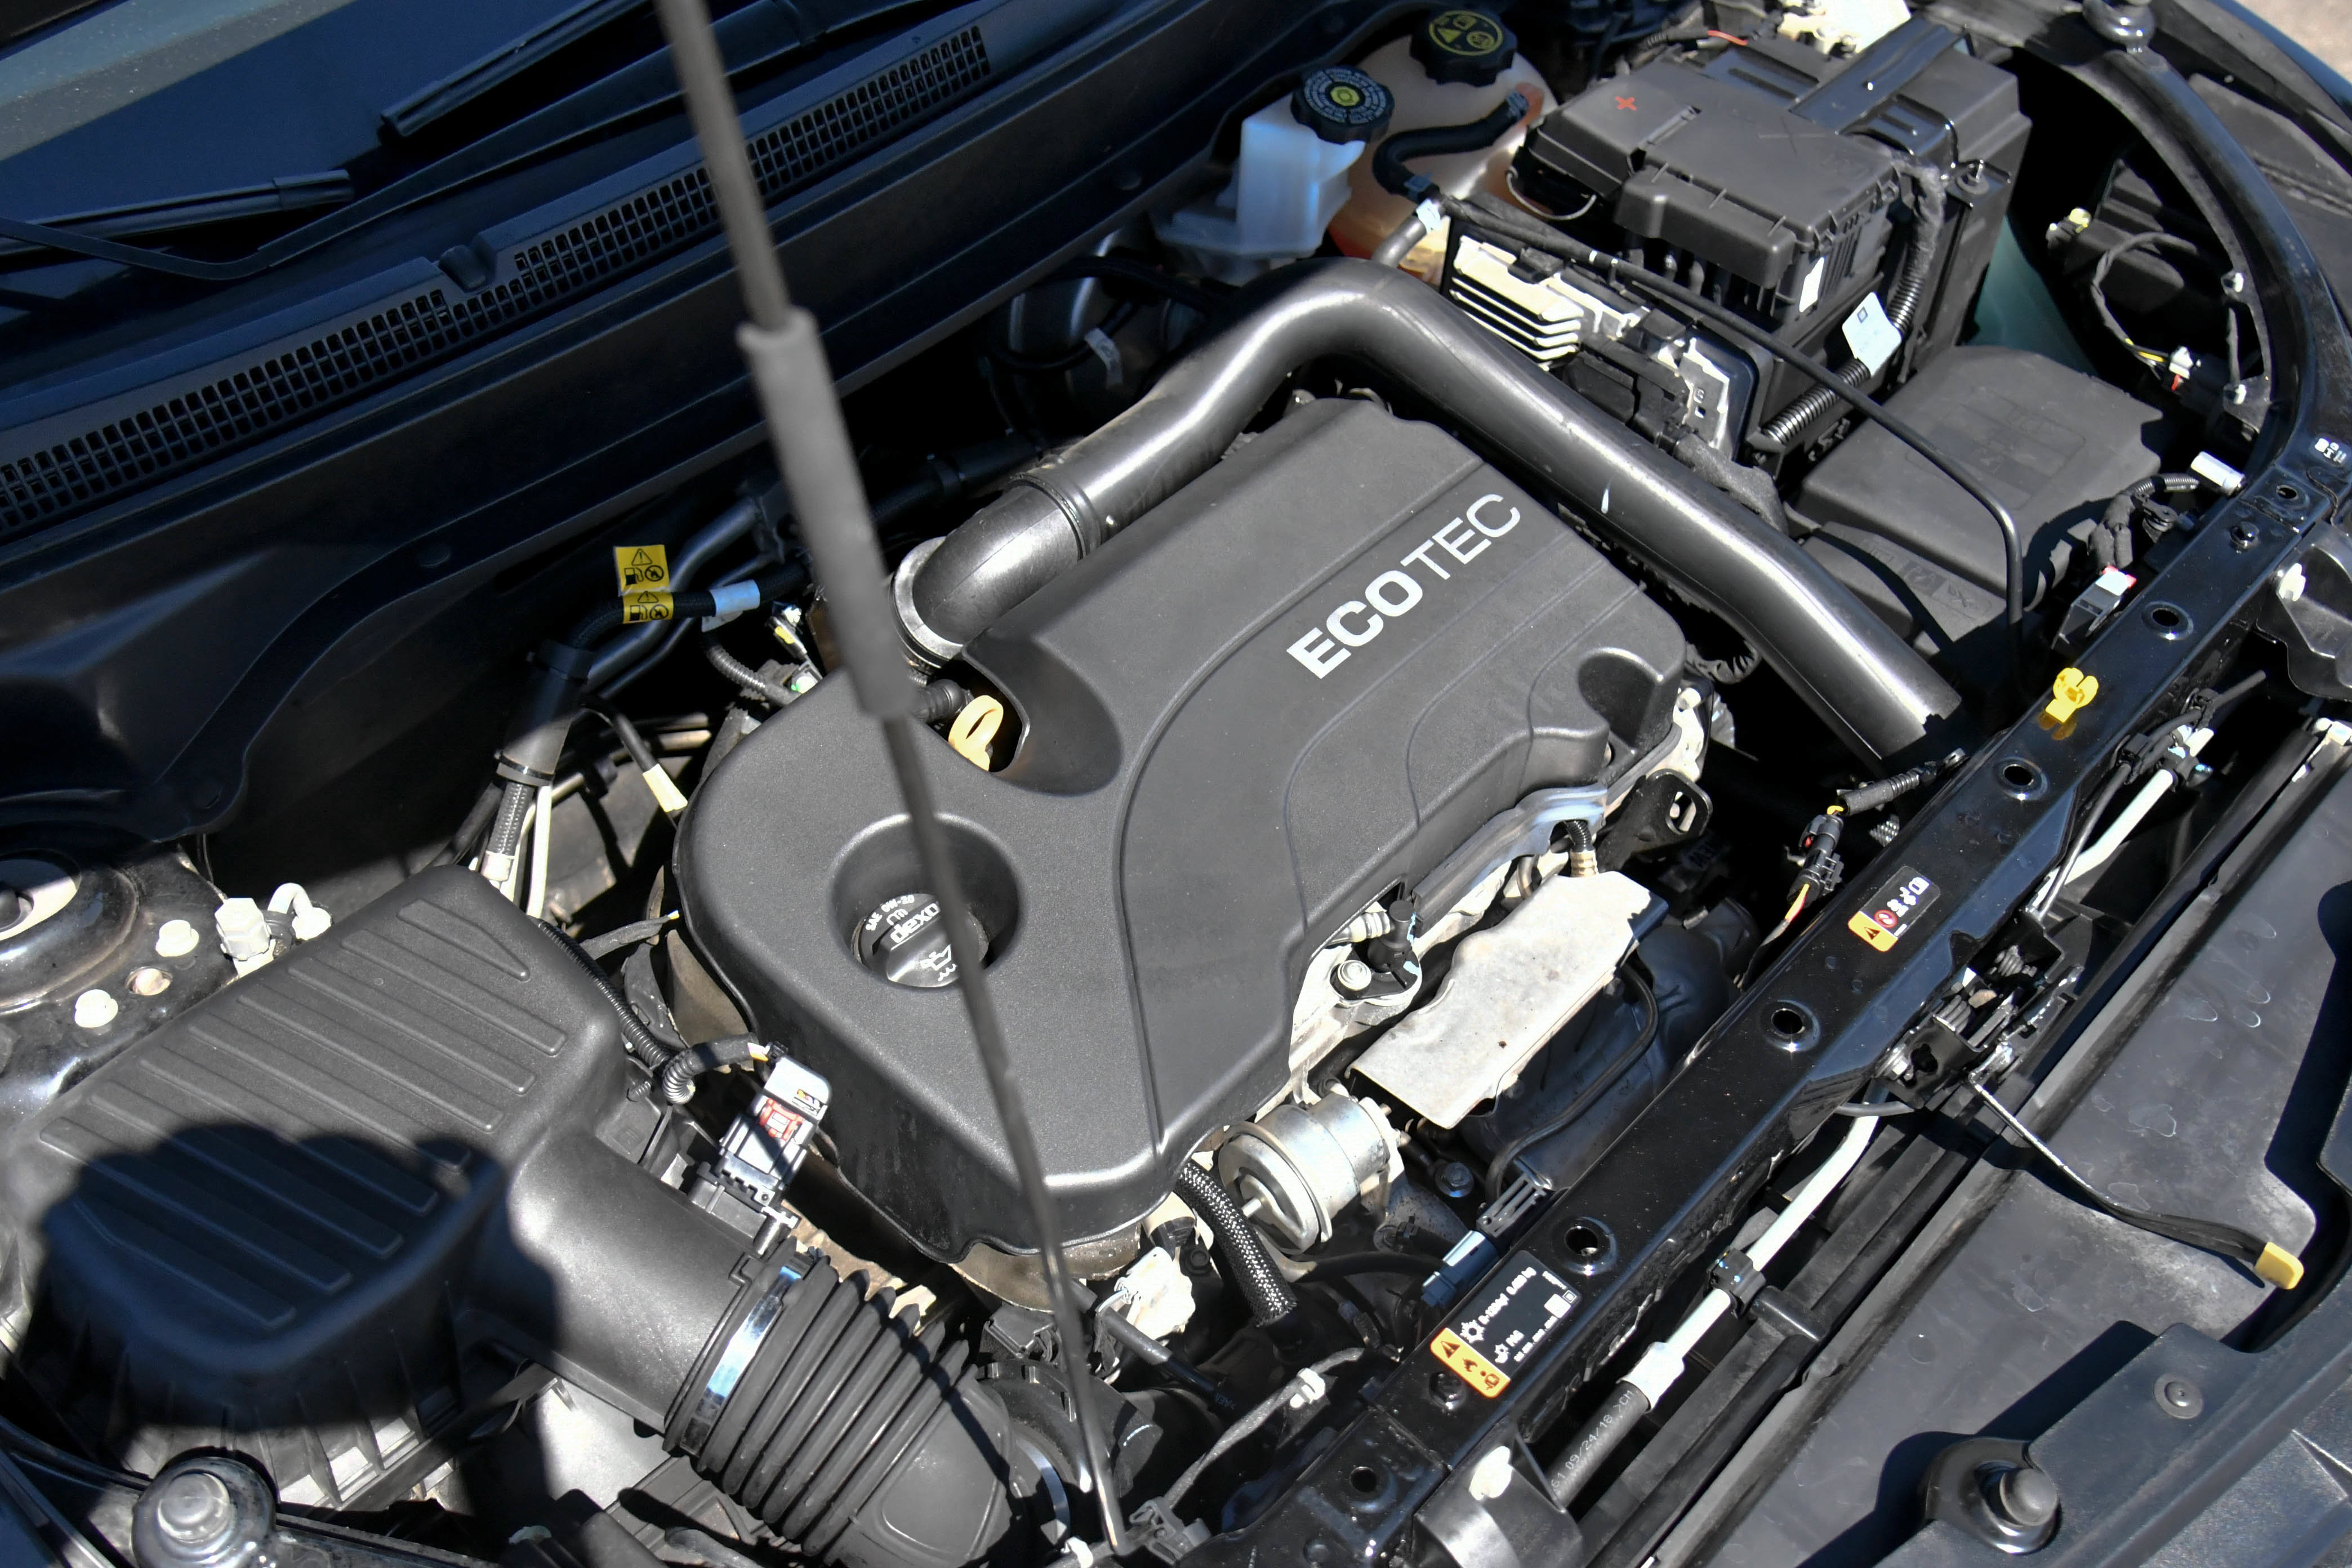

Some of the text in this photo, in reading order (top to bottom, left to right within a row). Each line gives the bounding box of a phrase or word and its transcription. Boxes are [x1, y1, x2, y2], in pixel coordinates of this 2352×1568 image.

[1286, 493, 1521, 679] ECOTEC
[865, 894, 915, 930] SAE 0W-20
[890, 903, 940, 943] dexo
[1565, 1414, 1613, 1469] 09/24/18
